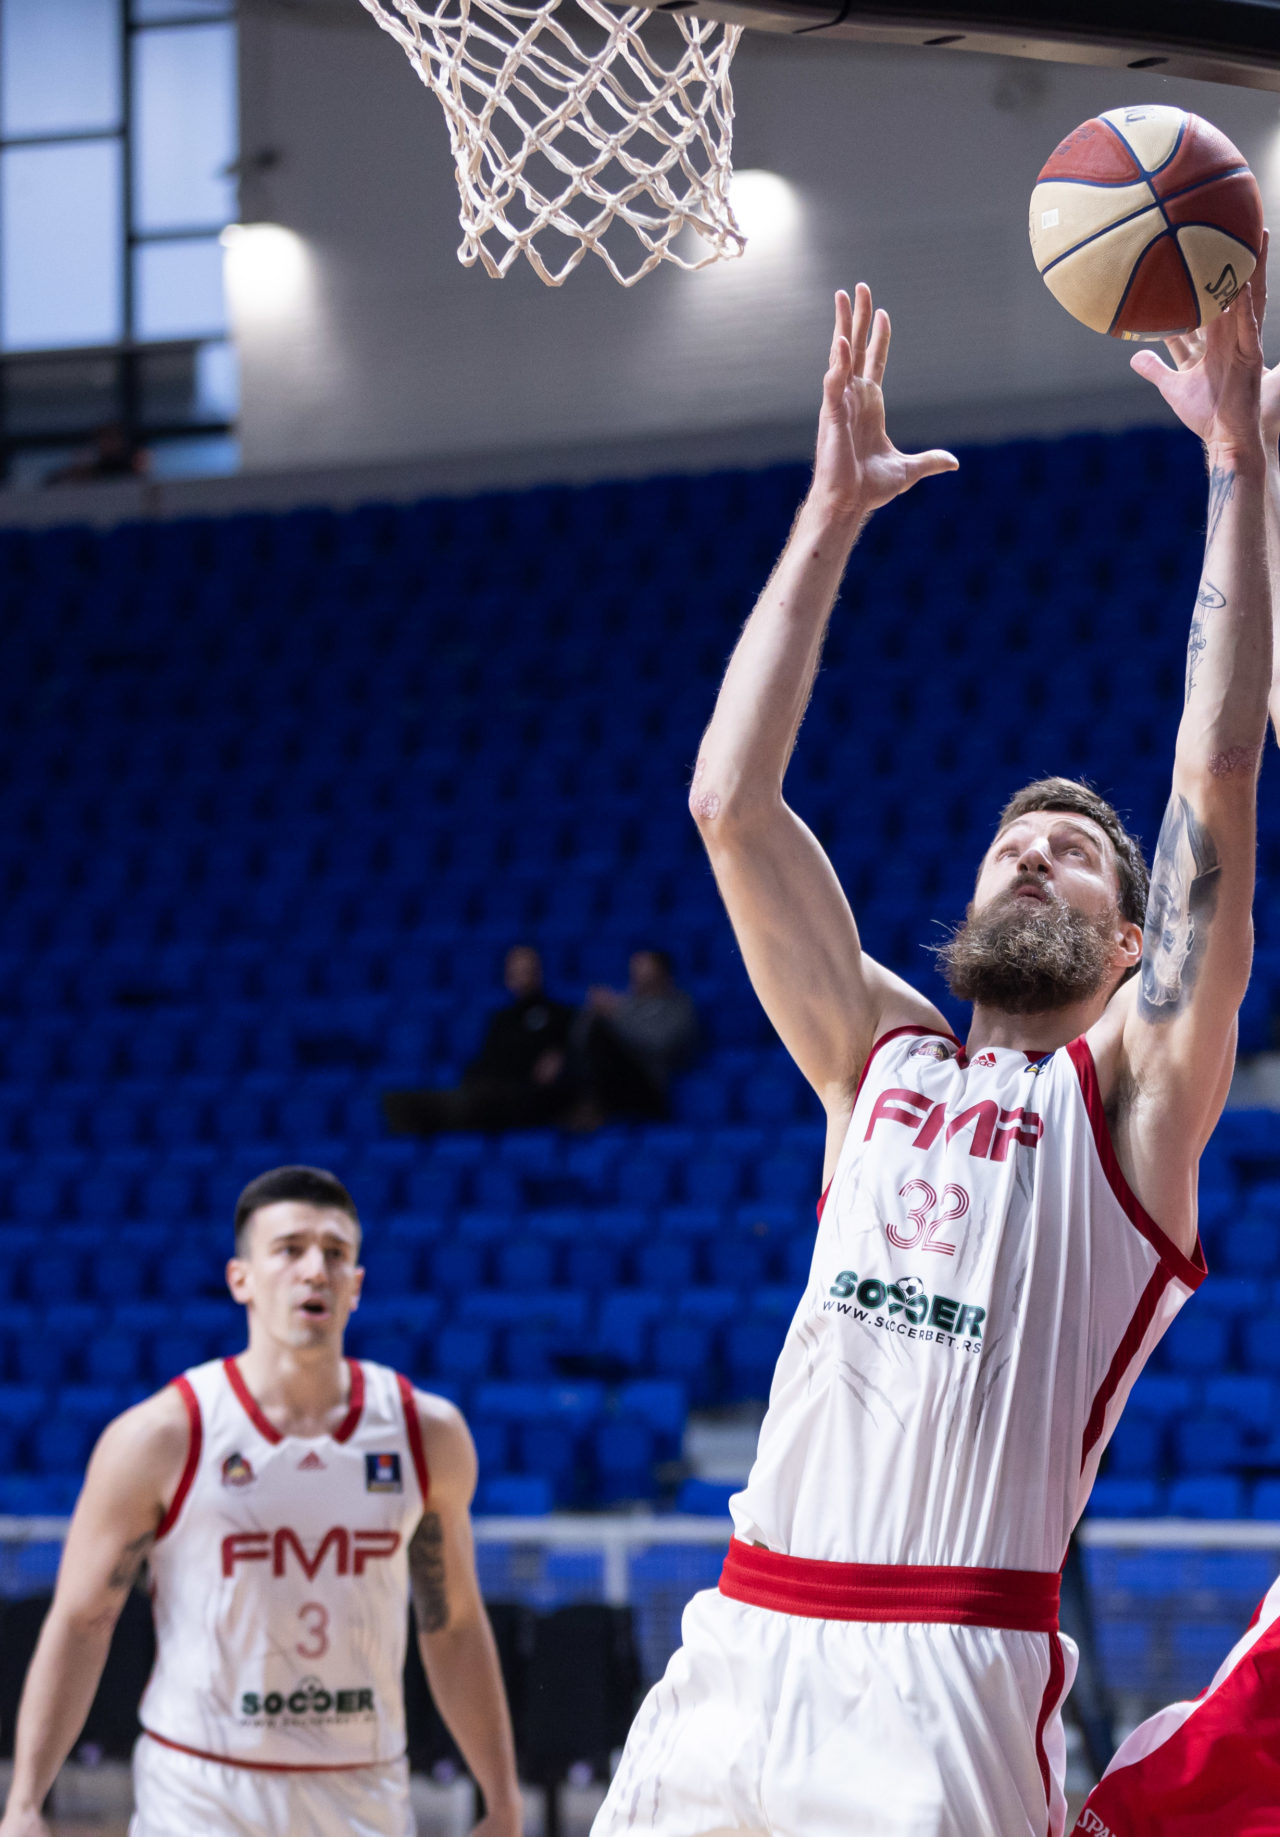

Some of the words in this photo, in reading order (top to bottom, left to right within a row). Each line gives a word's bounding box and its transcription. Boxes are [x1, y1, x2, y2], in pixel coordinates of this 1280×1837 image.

[863, 1087, 1045, 1163] FMP
[885, 1178, 970, 1257] 32
[829, 1270, 987, 1339] SOCCER
[221, 1525, 402, 1583] FMP
[296, 1601, 330, 1660] 3
[241, 1687, 376, 1716] SOCCER
